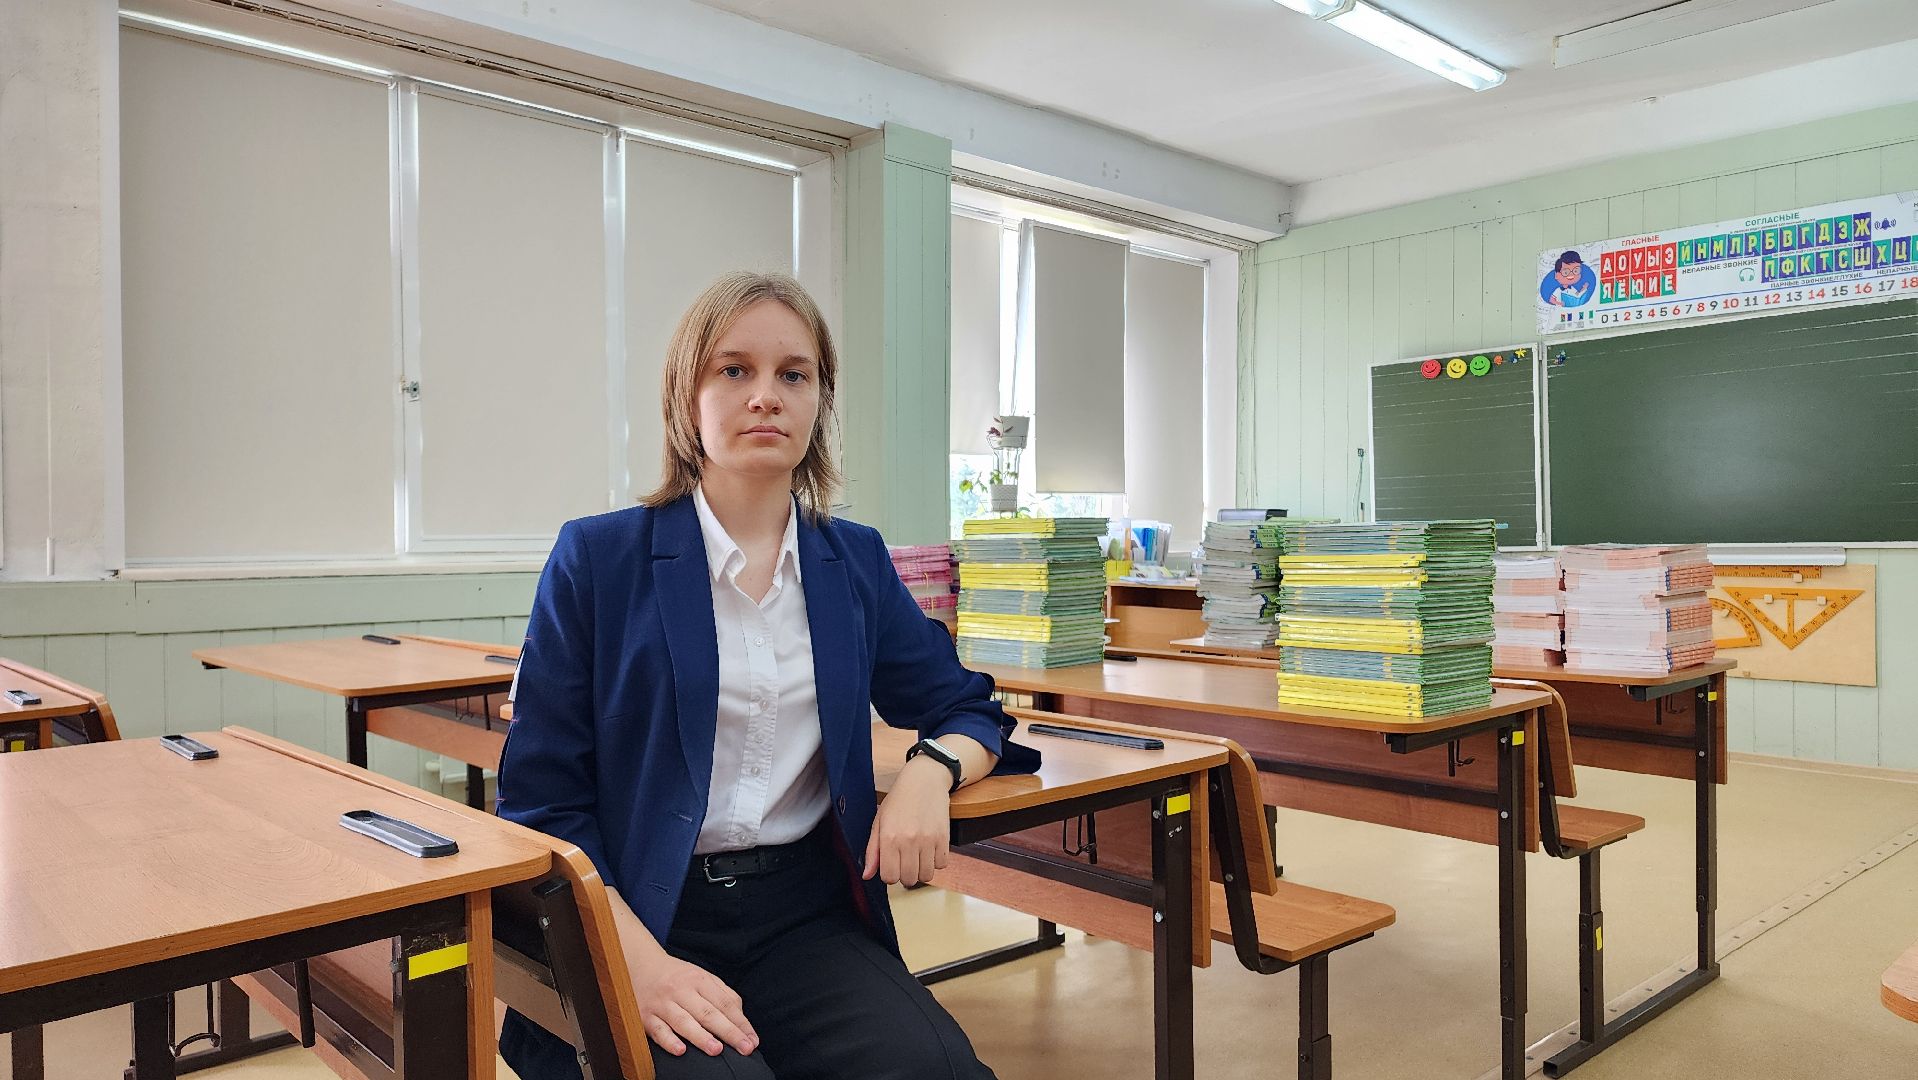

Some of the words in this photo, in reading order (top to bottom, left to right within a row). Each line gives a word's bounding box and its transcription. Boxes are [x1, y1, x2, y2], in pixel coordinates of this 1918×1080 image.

[1745, 212, 1800, 227] СОГЛАСНЫЕ
[1621, 235, 1660, 247] ГЛАСНЫЕ
[1681, 240, 1691, 262] Й
[1697, 242, 1707, 260] Н
[1713, 240, 1723, 258] М
[1729, 236, 1741, 255] Л
[1748, 234, 1758, 253] Р
[1764, 232, 1776, 250] Б
[1782, 229, 1793, 248] В
[1801, 226, 1810, 245] Г
[1818, 222, 1831, 244] Д
[1838, 220, 1848, 240] З
[1854, 218, 1870, 237] Ж
[1602, 257, 1612, 274] А
[1618, 254, 1627, 271] О
[1633, 252, 1643, 269] У
[1647, 250, 1660, 268] Ы
[1664, 247, 1674, 265] Э
[1722, 258, 1759, 269] ЗВОНКИЕ
[1764, 260, 1775, 279] П
[1781, 257, 1795, 275] Ф
[1800, 255, 1811, 274] К
[1819, 252, 1830, 271] Т
[1838, 249, 1848, 269] С
[1876, 244, 1888, 264] Х
[1894, 240, 1908, 261] Ц
[1602, 282, 1612, 300] Я
[1631, 278, 1644, 296] Ю
[1648, 276, 1658, 294] И
[1664, 273, 1673, 292] Е
[1770, 281, 1800, 289] ПАРНЫЕ
[1601, 314, 1609, 324] 0
[1612, 312, 1619, 322] 1
[1624, 311, 1631, 321] 2
[1635, 310, 1643, 320] 3
[1647, 308, 1656, 318] 4
[1660, 306, 1668, 317] 5
[1672, 305, 1681, 315] 6
[1685, 303, 1693, 314] 7
[1696, 302, 1705, 312] 8
[1709, 300, 1718, 311] 9
[1722, 298, 1739, 309] 10
[1744, 295, 1759, 307] 11
[1764, 293, 1781, 305] 12
[1786, 291, 1803, 302] 13
[1808, 288, 1825, 300] 14
[1831, 285, 1849, 297] 15
[1854, 282, 1872, 295] 16
[1878, 280, 1895, 292] 17
[1900, 276, 1918, 289] 18
